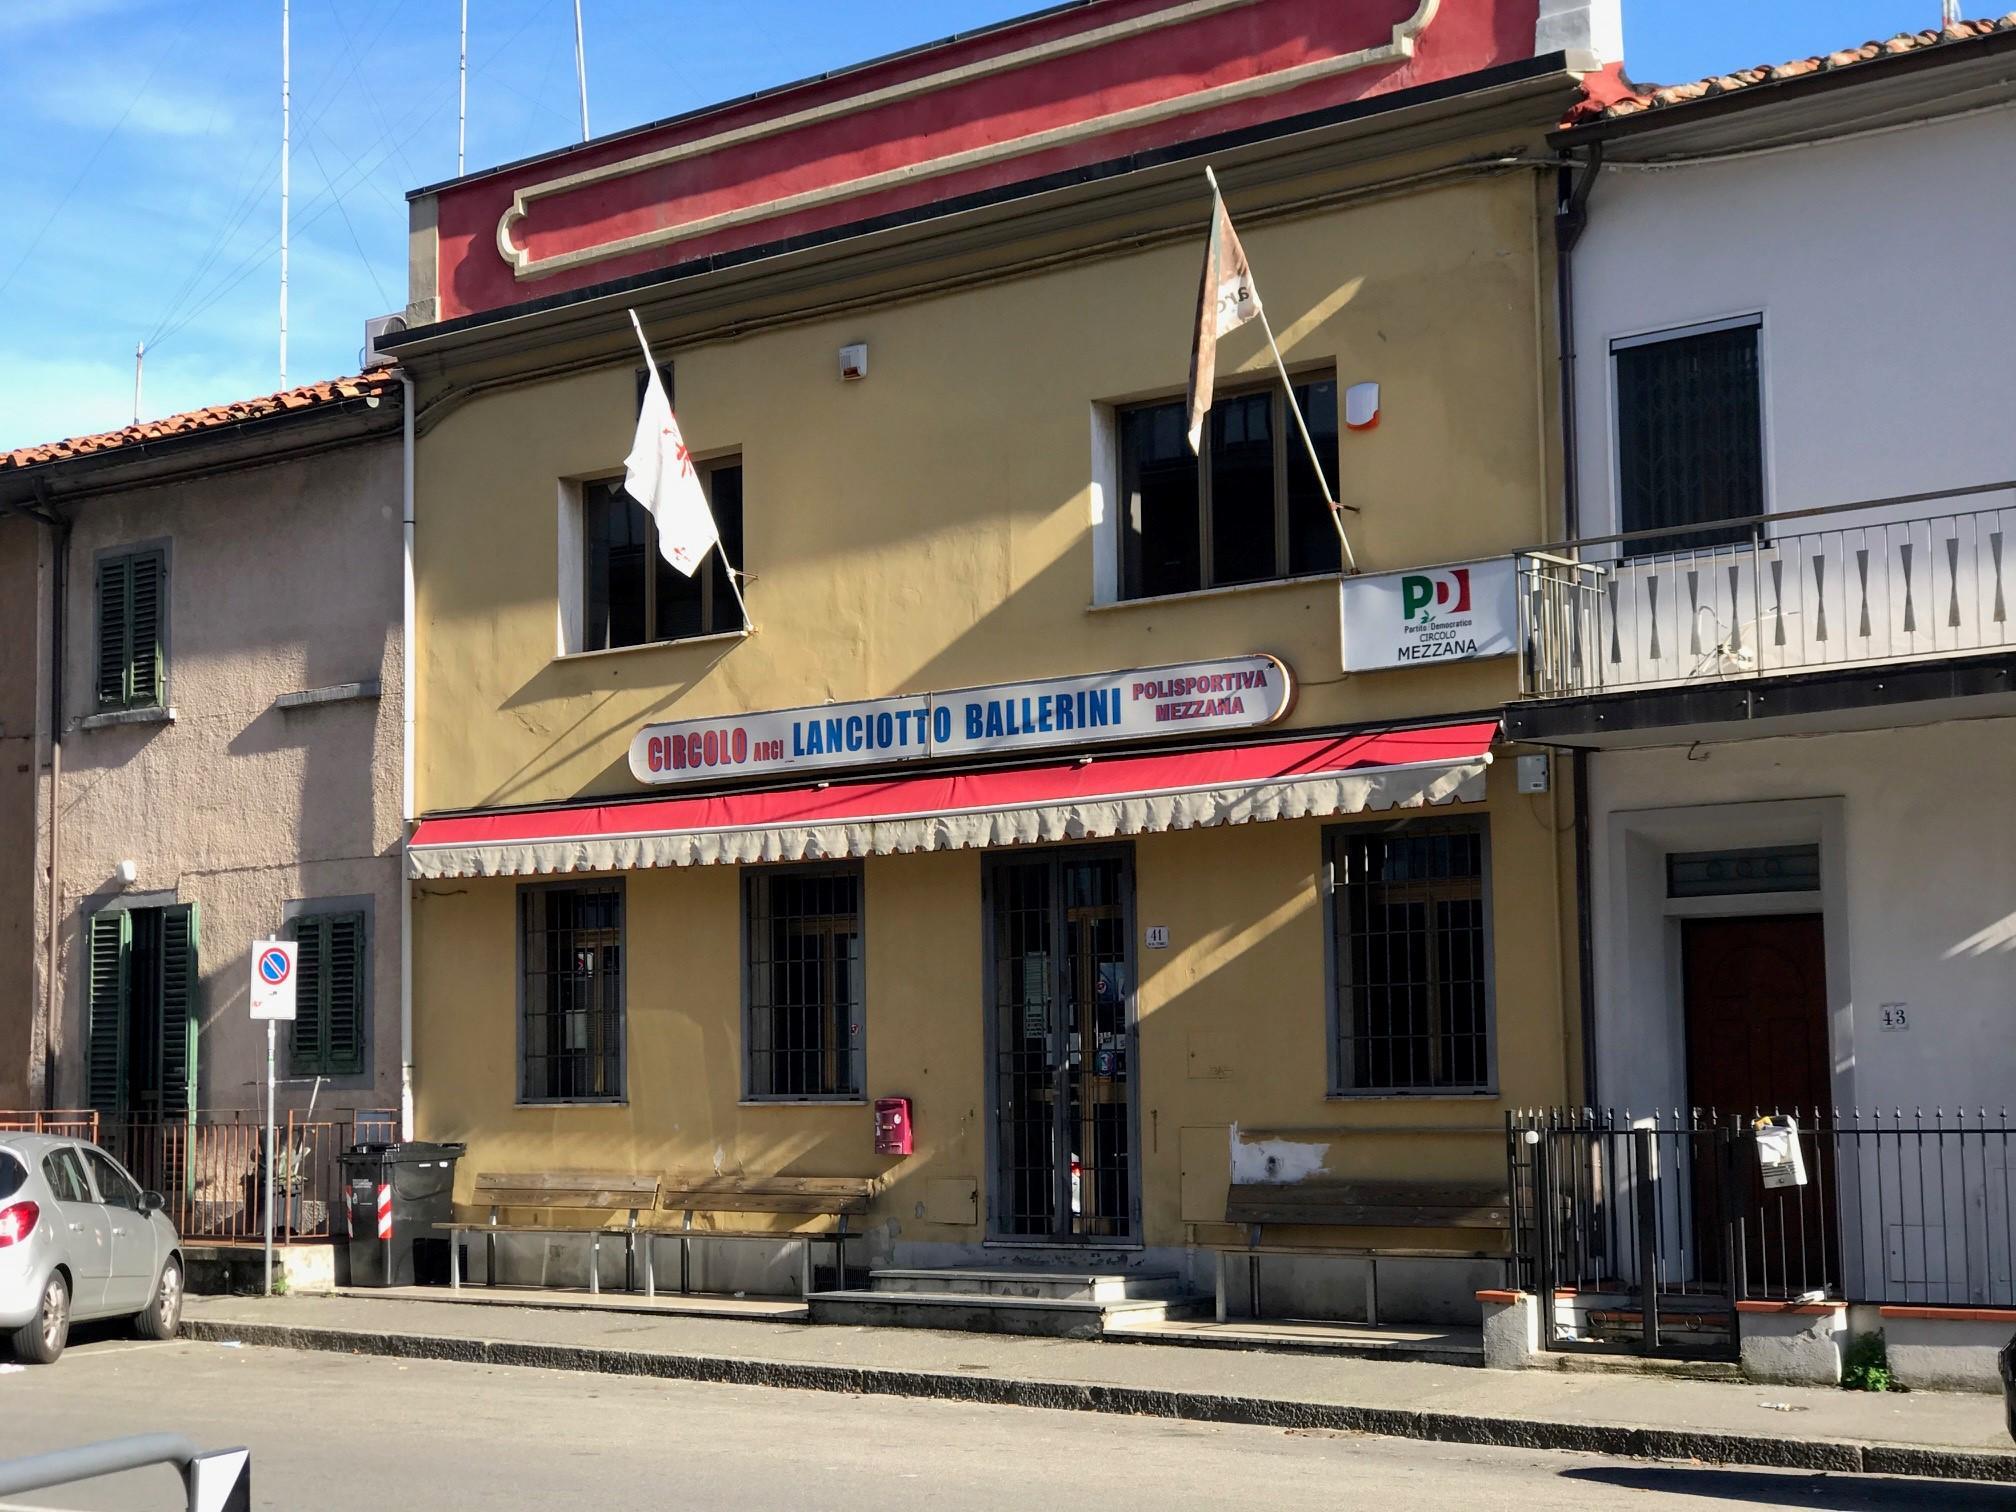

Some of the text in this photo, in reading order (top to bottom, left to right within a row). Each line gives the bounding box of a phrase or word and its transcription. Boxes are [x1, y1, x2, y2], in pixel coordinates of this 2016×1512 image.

[1404, 620, 1472, 634] Partito Democratico
[1420, 630, 1456, 642] CIRCOLO
[1398, 639, 1478, 661] MEZZANA
[1132, 670, 1267, 701] POLISPORTIVA
[1155, 697, 1245, 722] MEZZANA
[648, 688, 1121, 772] CIRCOLO ARCI LANCIOTTO BALLERINI
[1150, 928, 1162, 941] 41
[1882, 1009, 1906, 1026] 43
